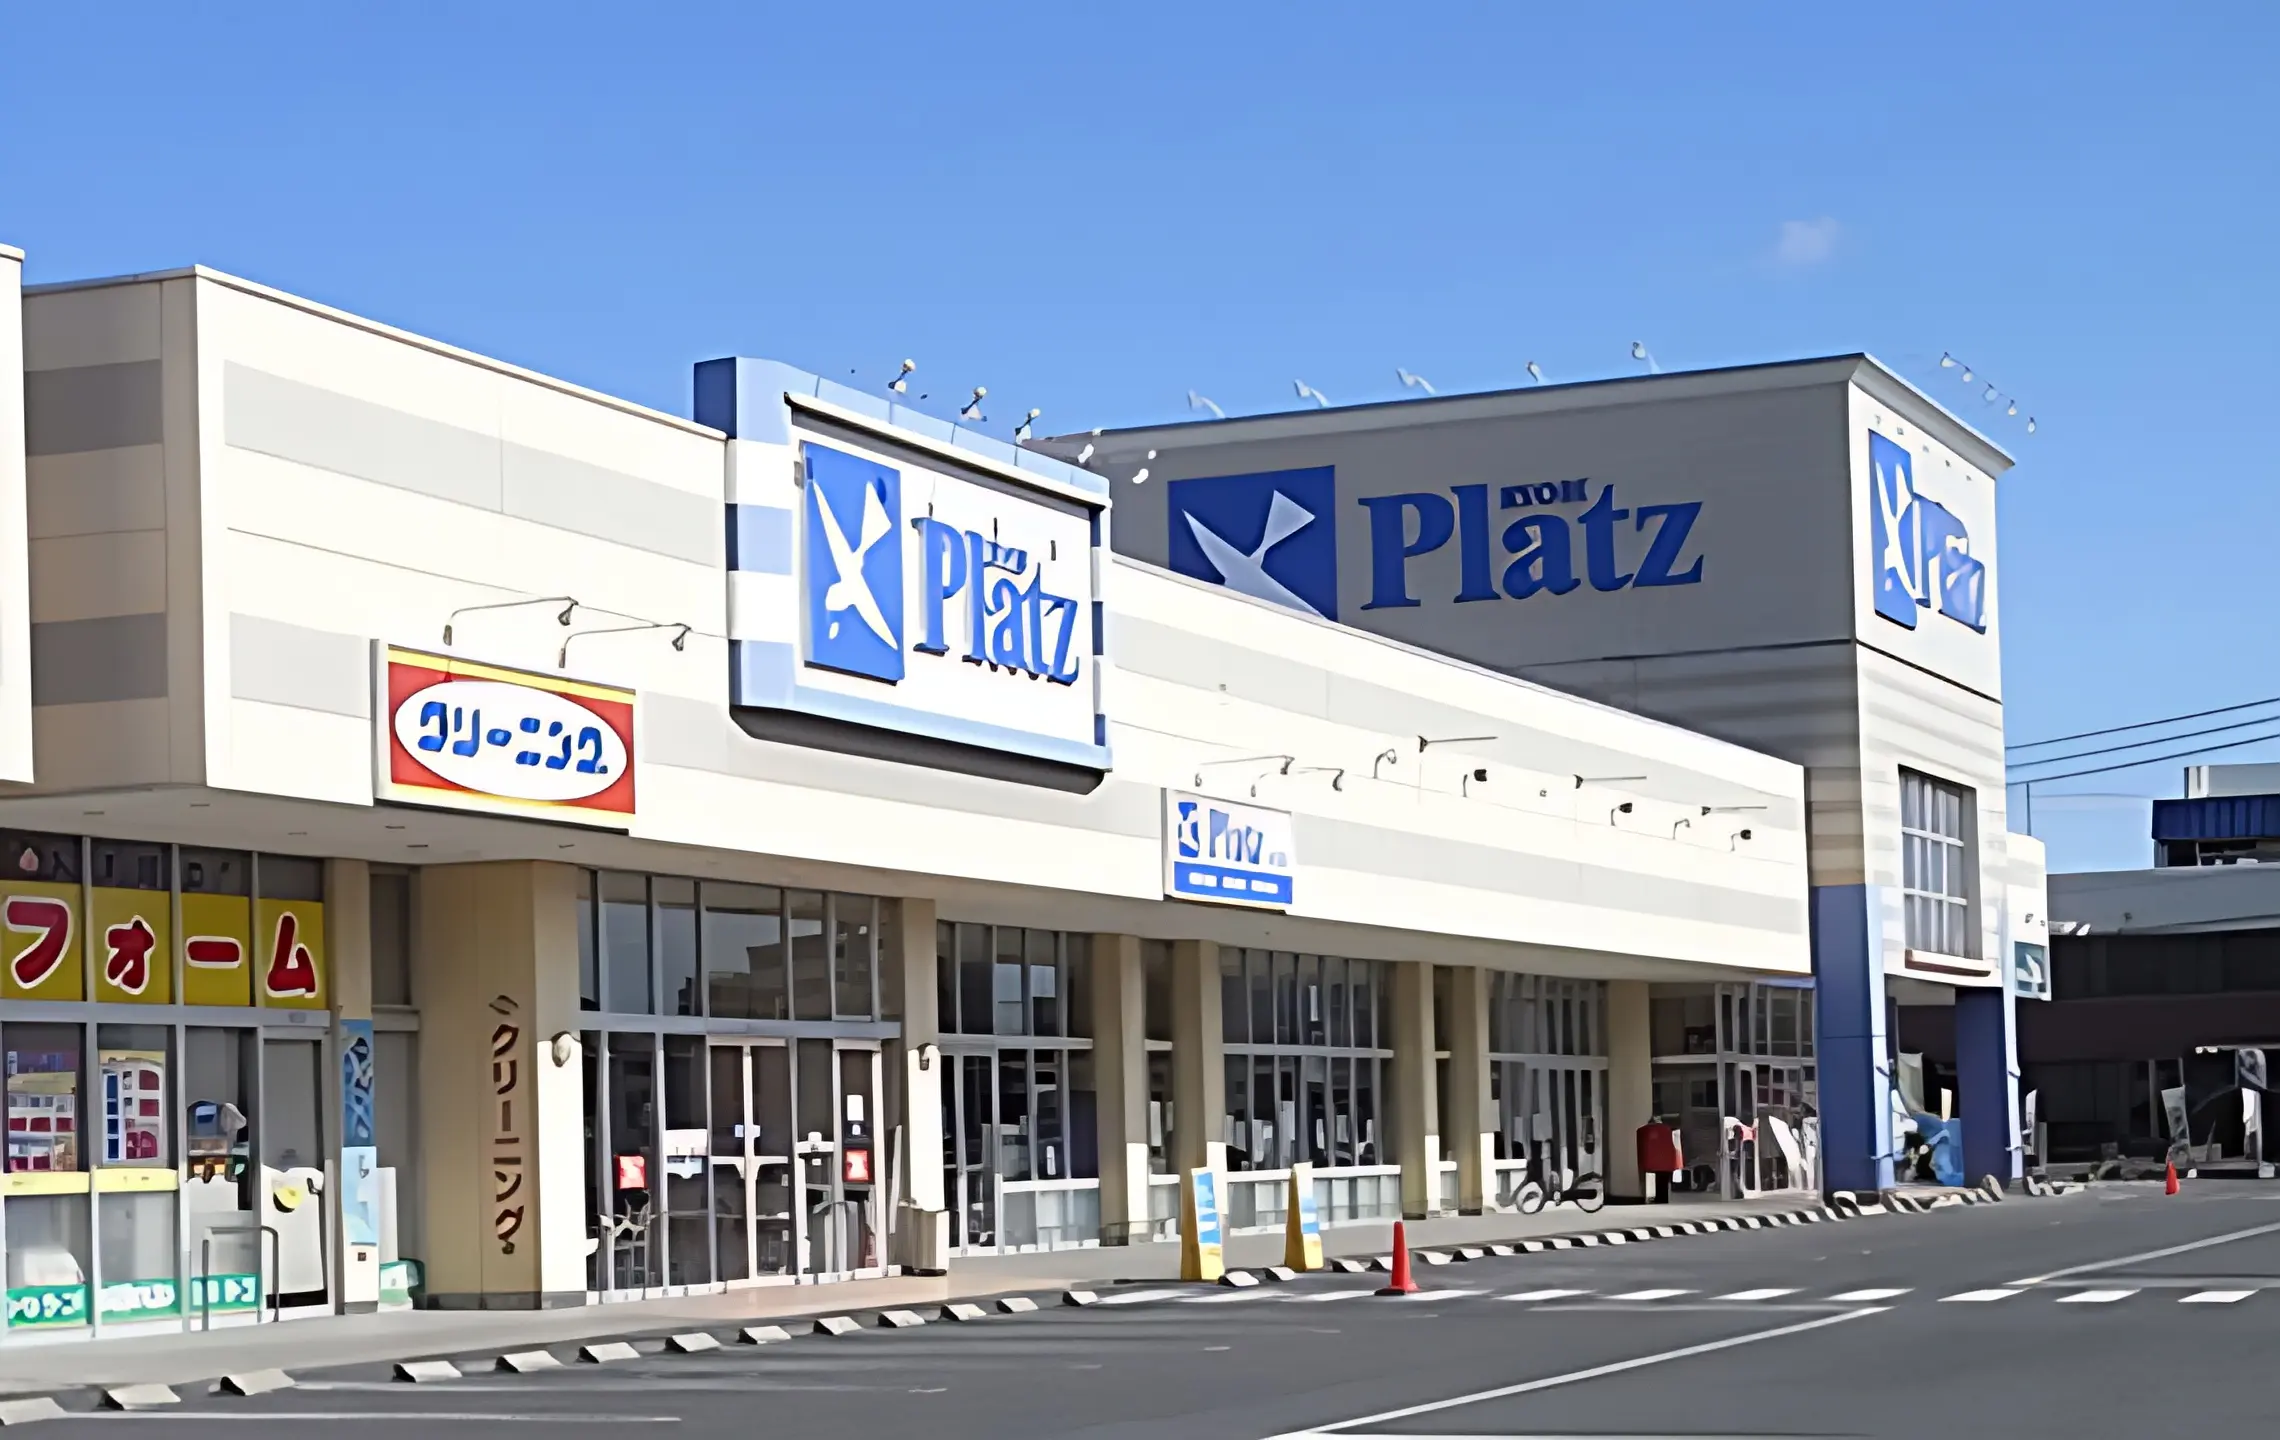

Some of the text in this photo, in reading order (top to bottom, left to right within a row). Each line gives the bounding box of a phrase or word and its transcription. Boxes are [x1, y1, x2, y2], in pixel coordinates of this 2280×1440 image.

[910, 517, 1080, 684] Platz
[1357, 483, 1705, 610] Platz
[5, 895, 317, 997] フォーム
